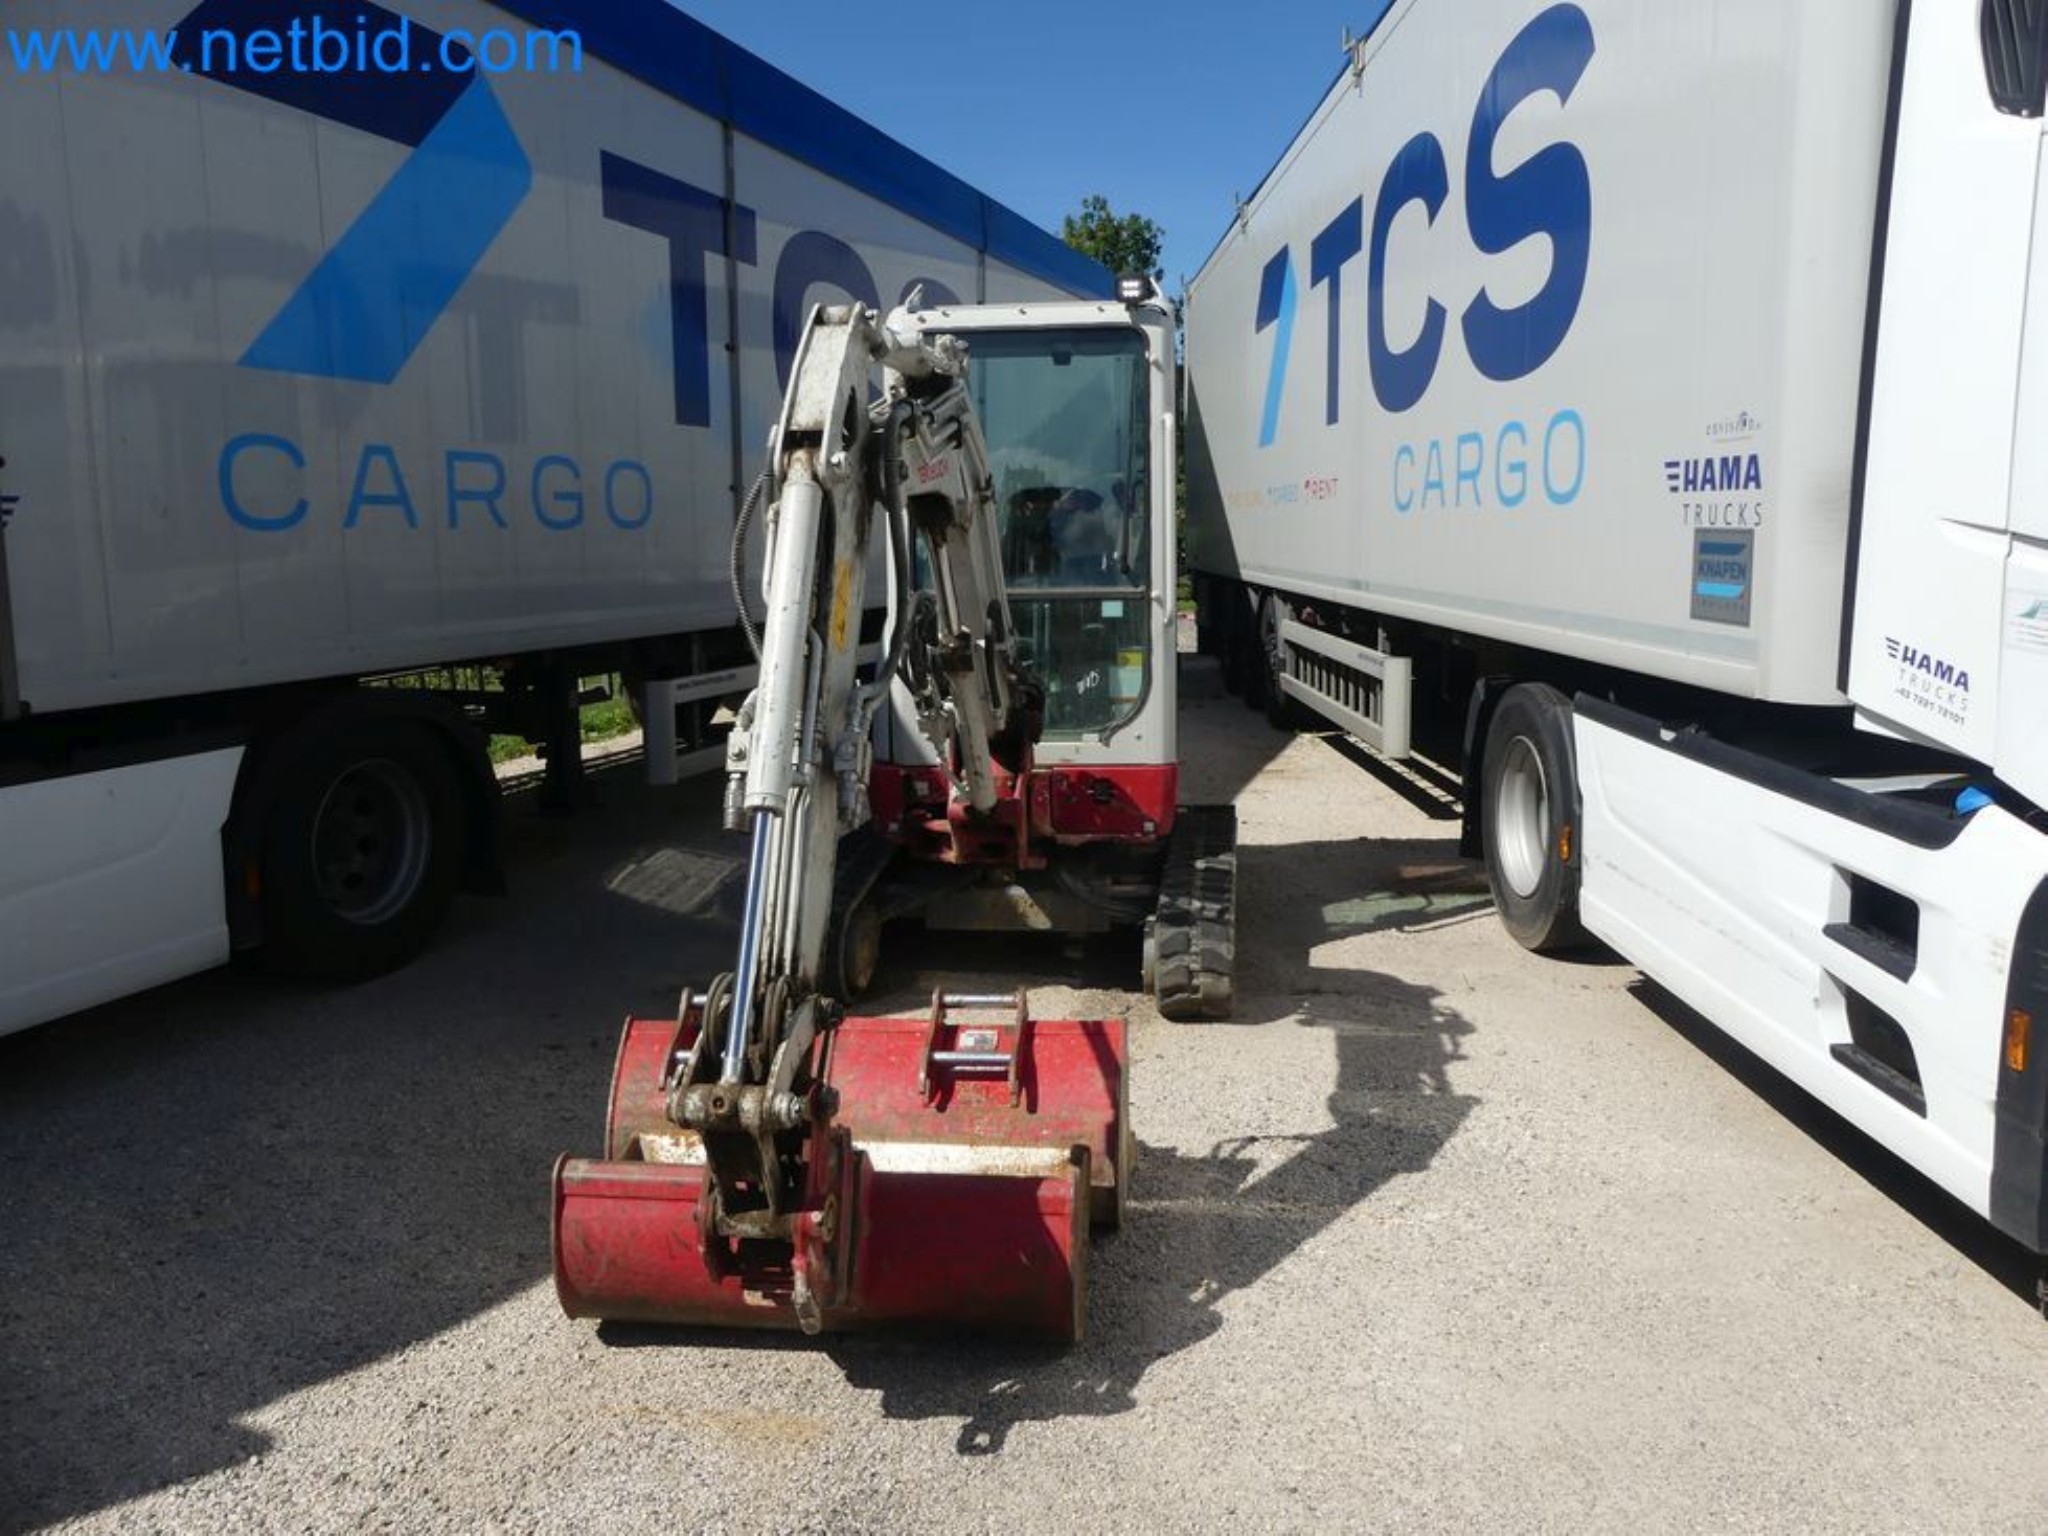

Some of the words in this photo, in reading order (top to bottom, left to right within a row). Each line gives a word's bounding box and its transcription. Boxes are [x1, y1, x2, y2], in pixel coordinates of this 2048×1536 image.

[1311, 2, 1596, 426] TCS
[217, 432, 654, 531] CARGO
[1393, 408, 1585, 513] CARGO
[1682, 453, 1762, 493] HAMA
[1682, 502, 1763, 527] TRUCKS
[1698, 558, 1747, 580] KNAPEN
[1898, 668, 1969, 712] TRUCKS
[1902, 645, 1970, 693] HAMA
